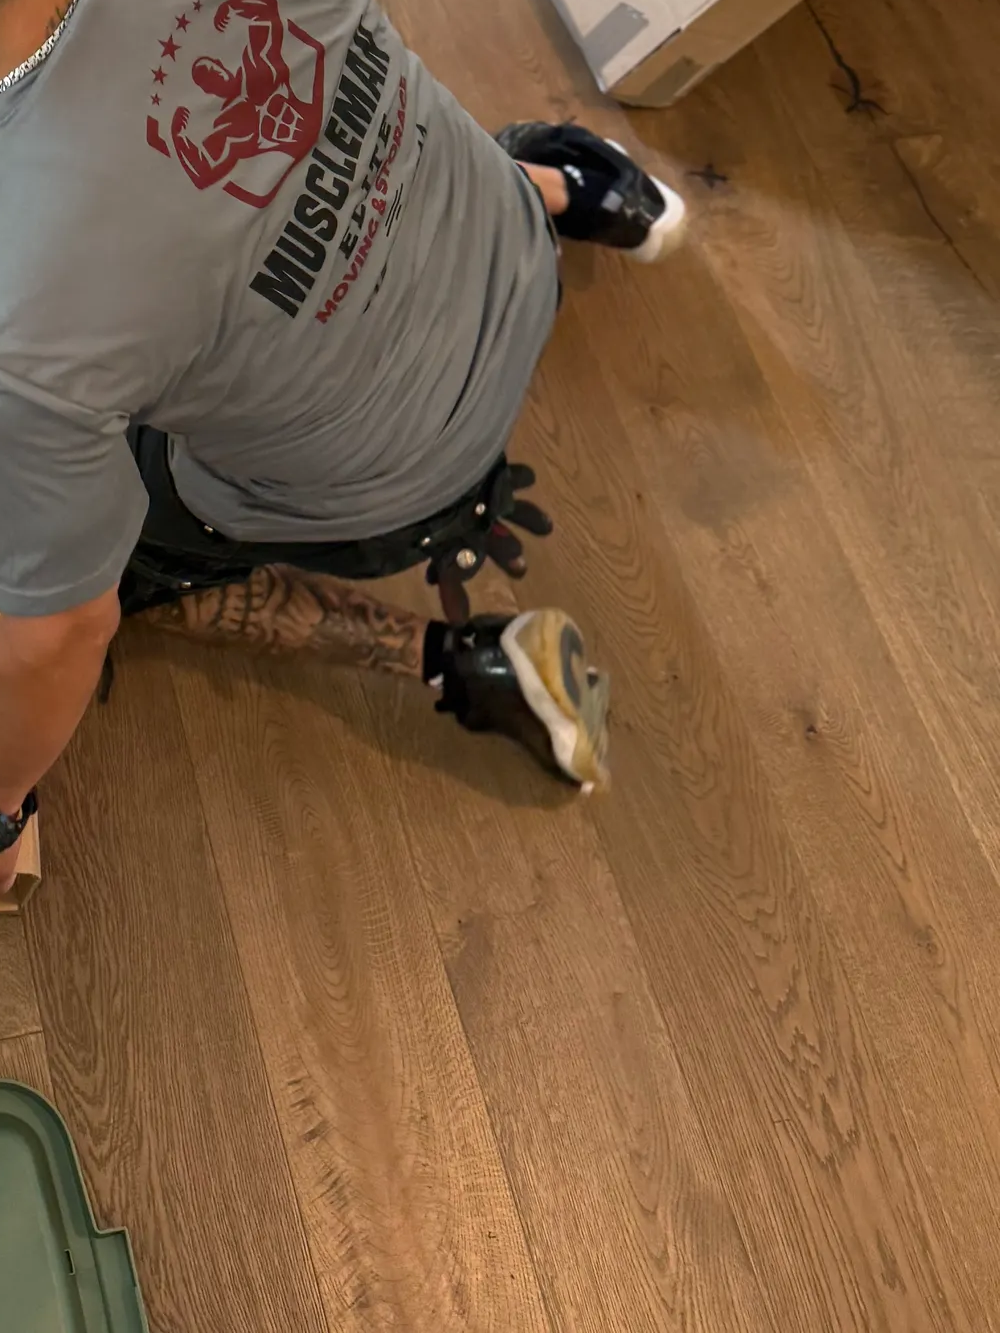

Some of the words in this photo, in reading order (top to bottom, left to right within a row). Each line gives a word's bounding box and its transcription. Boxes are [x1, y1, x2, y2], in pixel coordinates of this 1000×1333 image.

[249, 14, 391, 319] MUSCLEMAN
[339, 112, 392, 261] ELITE
[374, 74, 408, 197] STORAGE
[371, 196, 387, 217] &
[315, 217, 380, 324] MOVING
